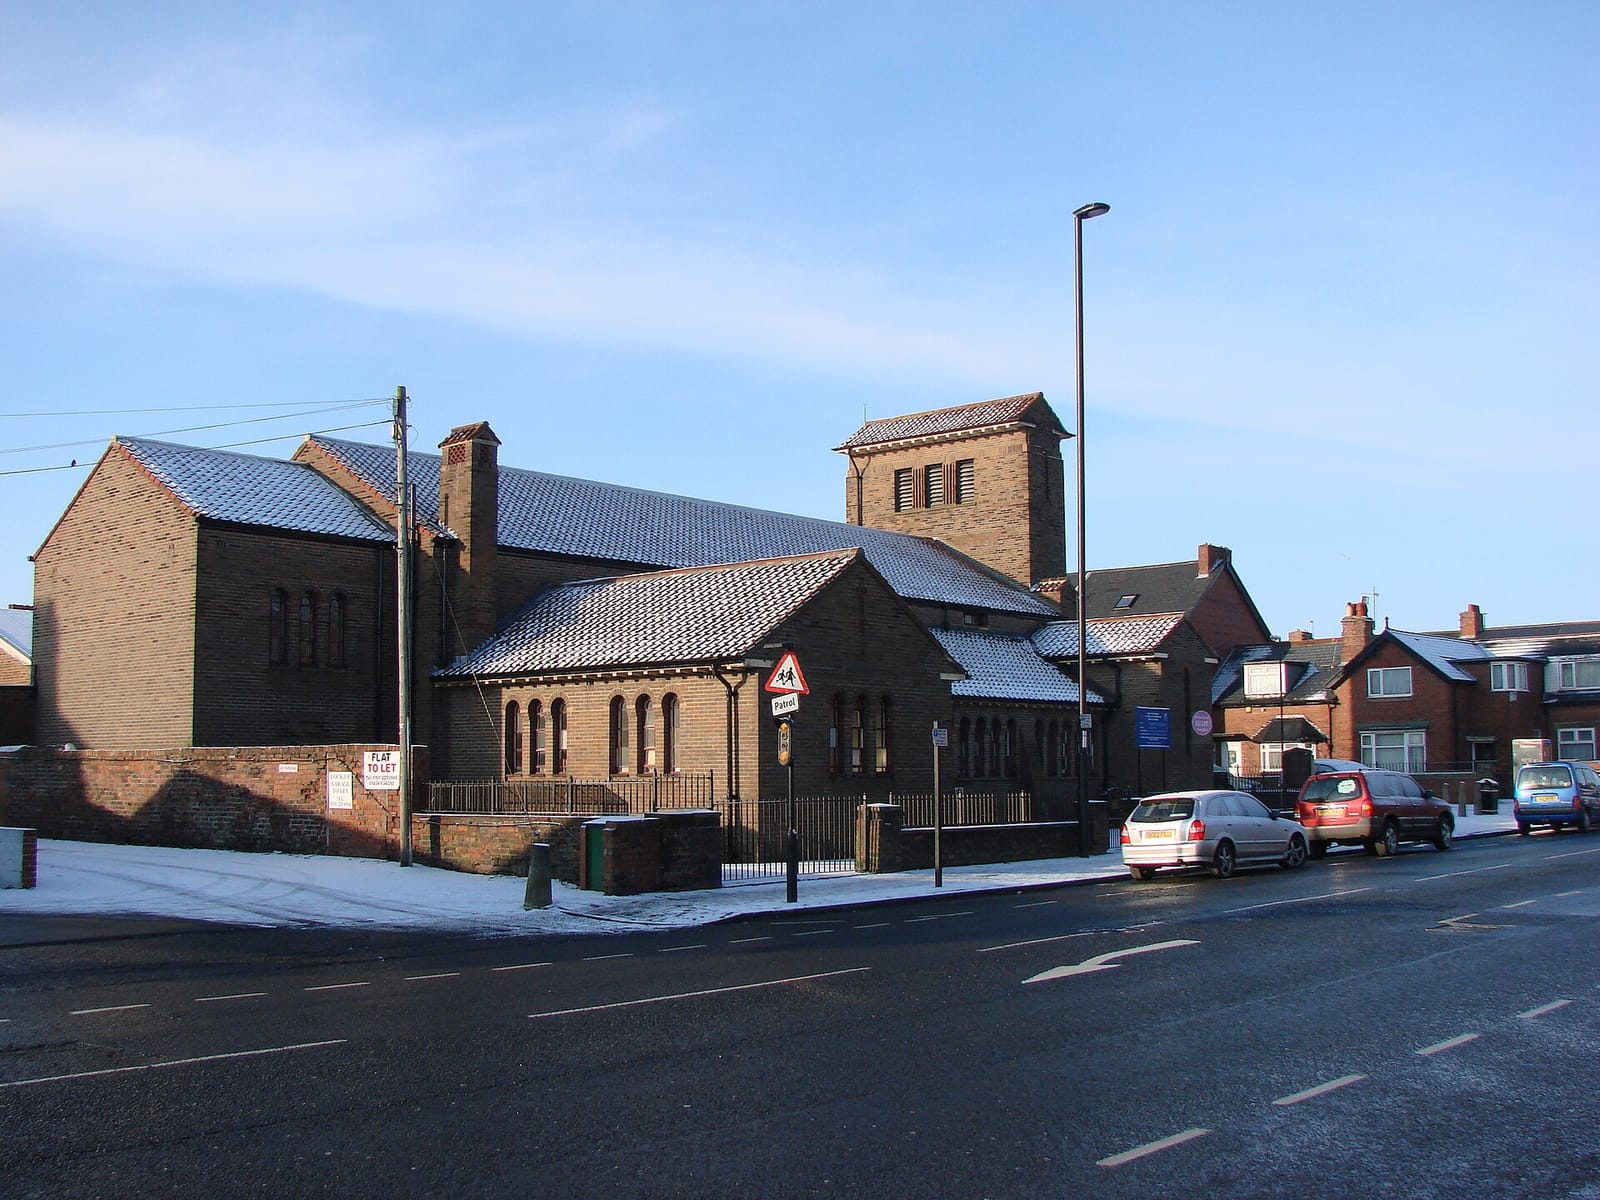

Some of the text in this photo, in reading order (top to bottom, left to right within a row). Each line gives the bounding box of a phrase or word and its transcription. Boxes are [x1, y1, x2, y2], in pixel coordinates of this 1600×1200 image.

[774, 697, 796, 710] Patrol
[371, 752, 391, 761] FLAT
[367, 763, 396, 773] TO LET
